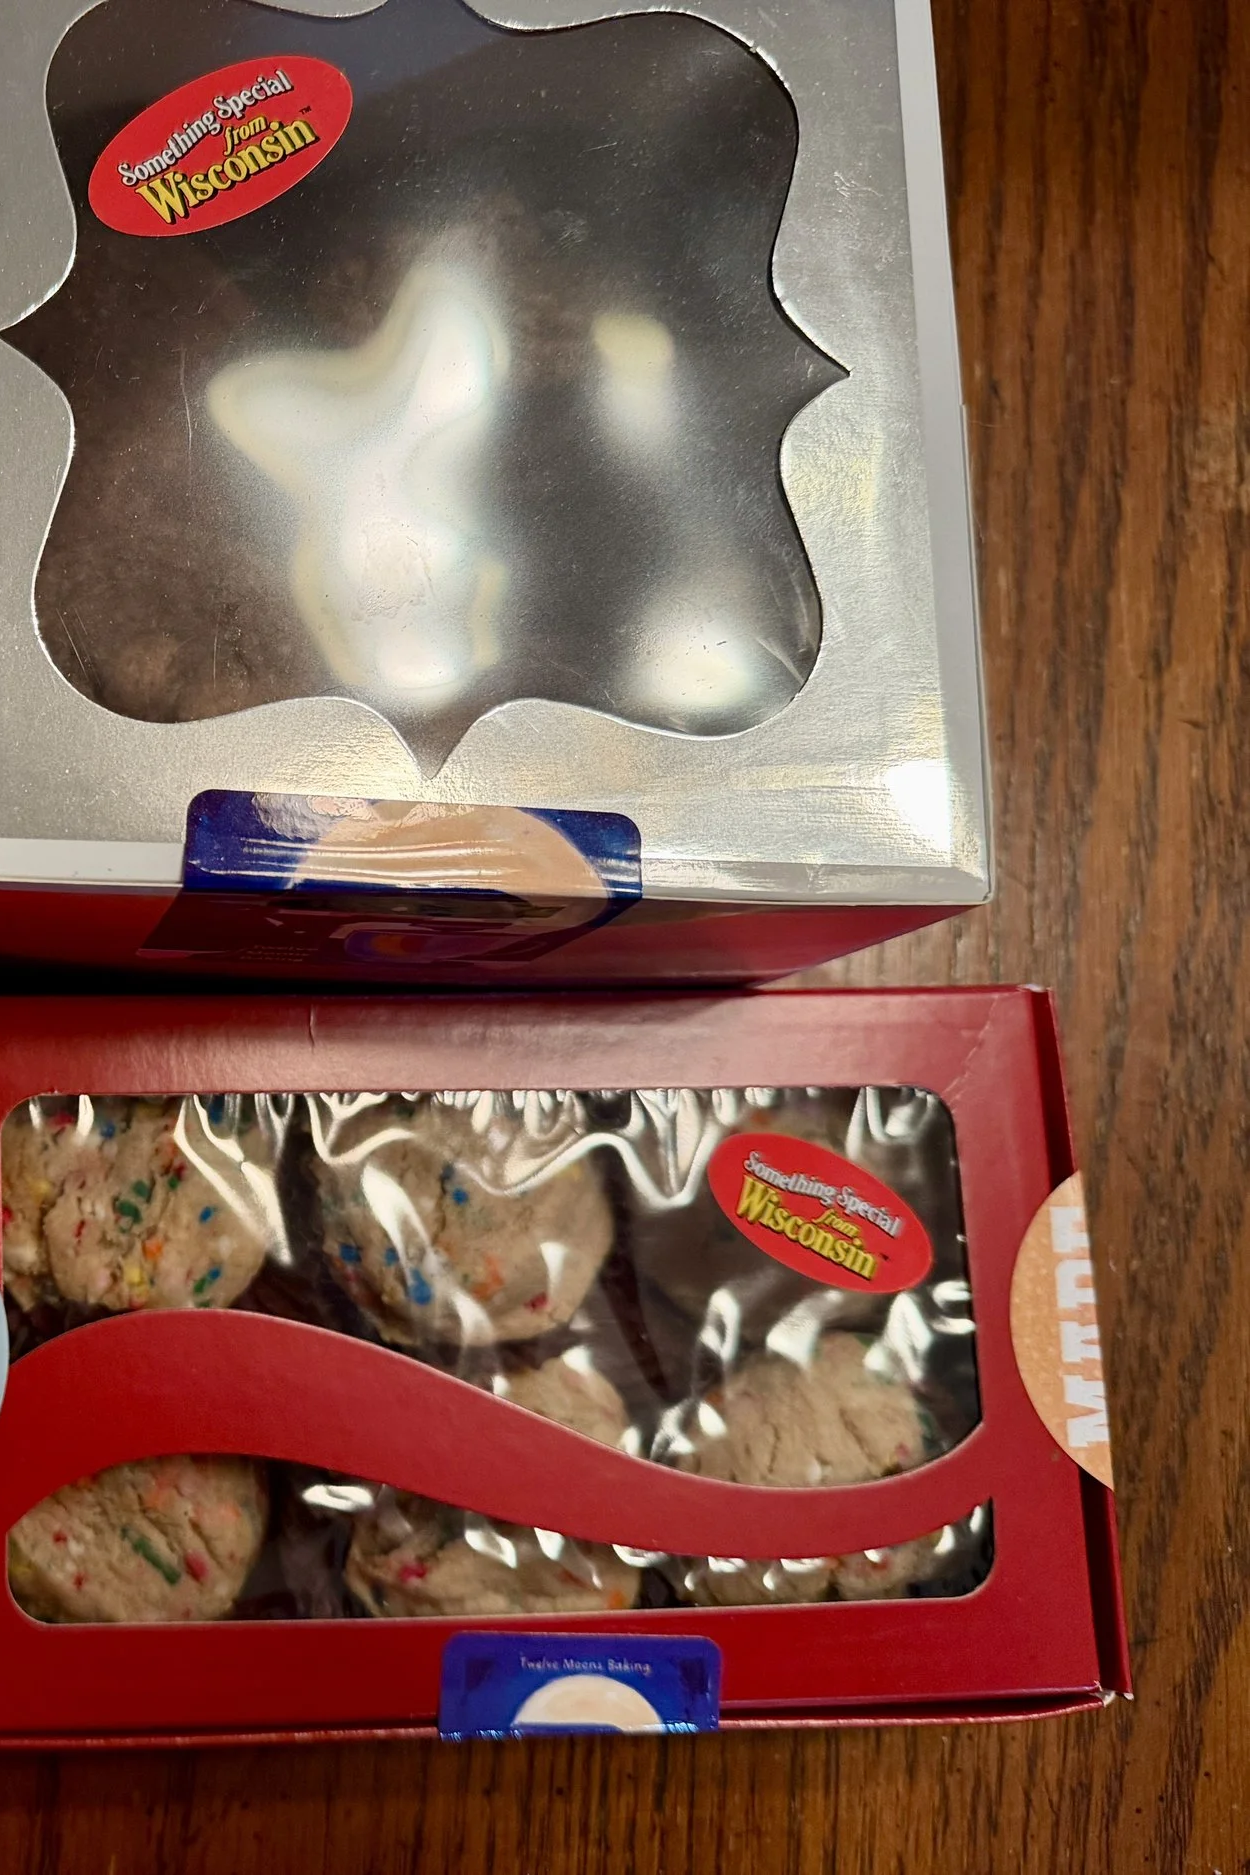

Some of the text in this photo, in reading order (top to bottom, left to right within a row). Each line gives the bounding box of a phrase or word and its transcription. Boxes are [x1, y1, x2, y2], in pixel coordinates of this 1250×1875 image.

[117, 69, 293, 186] Something Special
[224, 116, 269, 155] from
[135, 119, 320, 225] Wisconsin
[736, 1174, 877, 1280] Wisconsin
[743, 1150, 901, 1238] Something Special
[813, 1209, 860, 1238] from
[519, 1654, 651, 1676] Twelve Moons Baking
